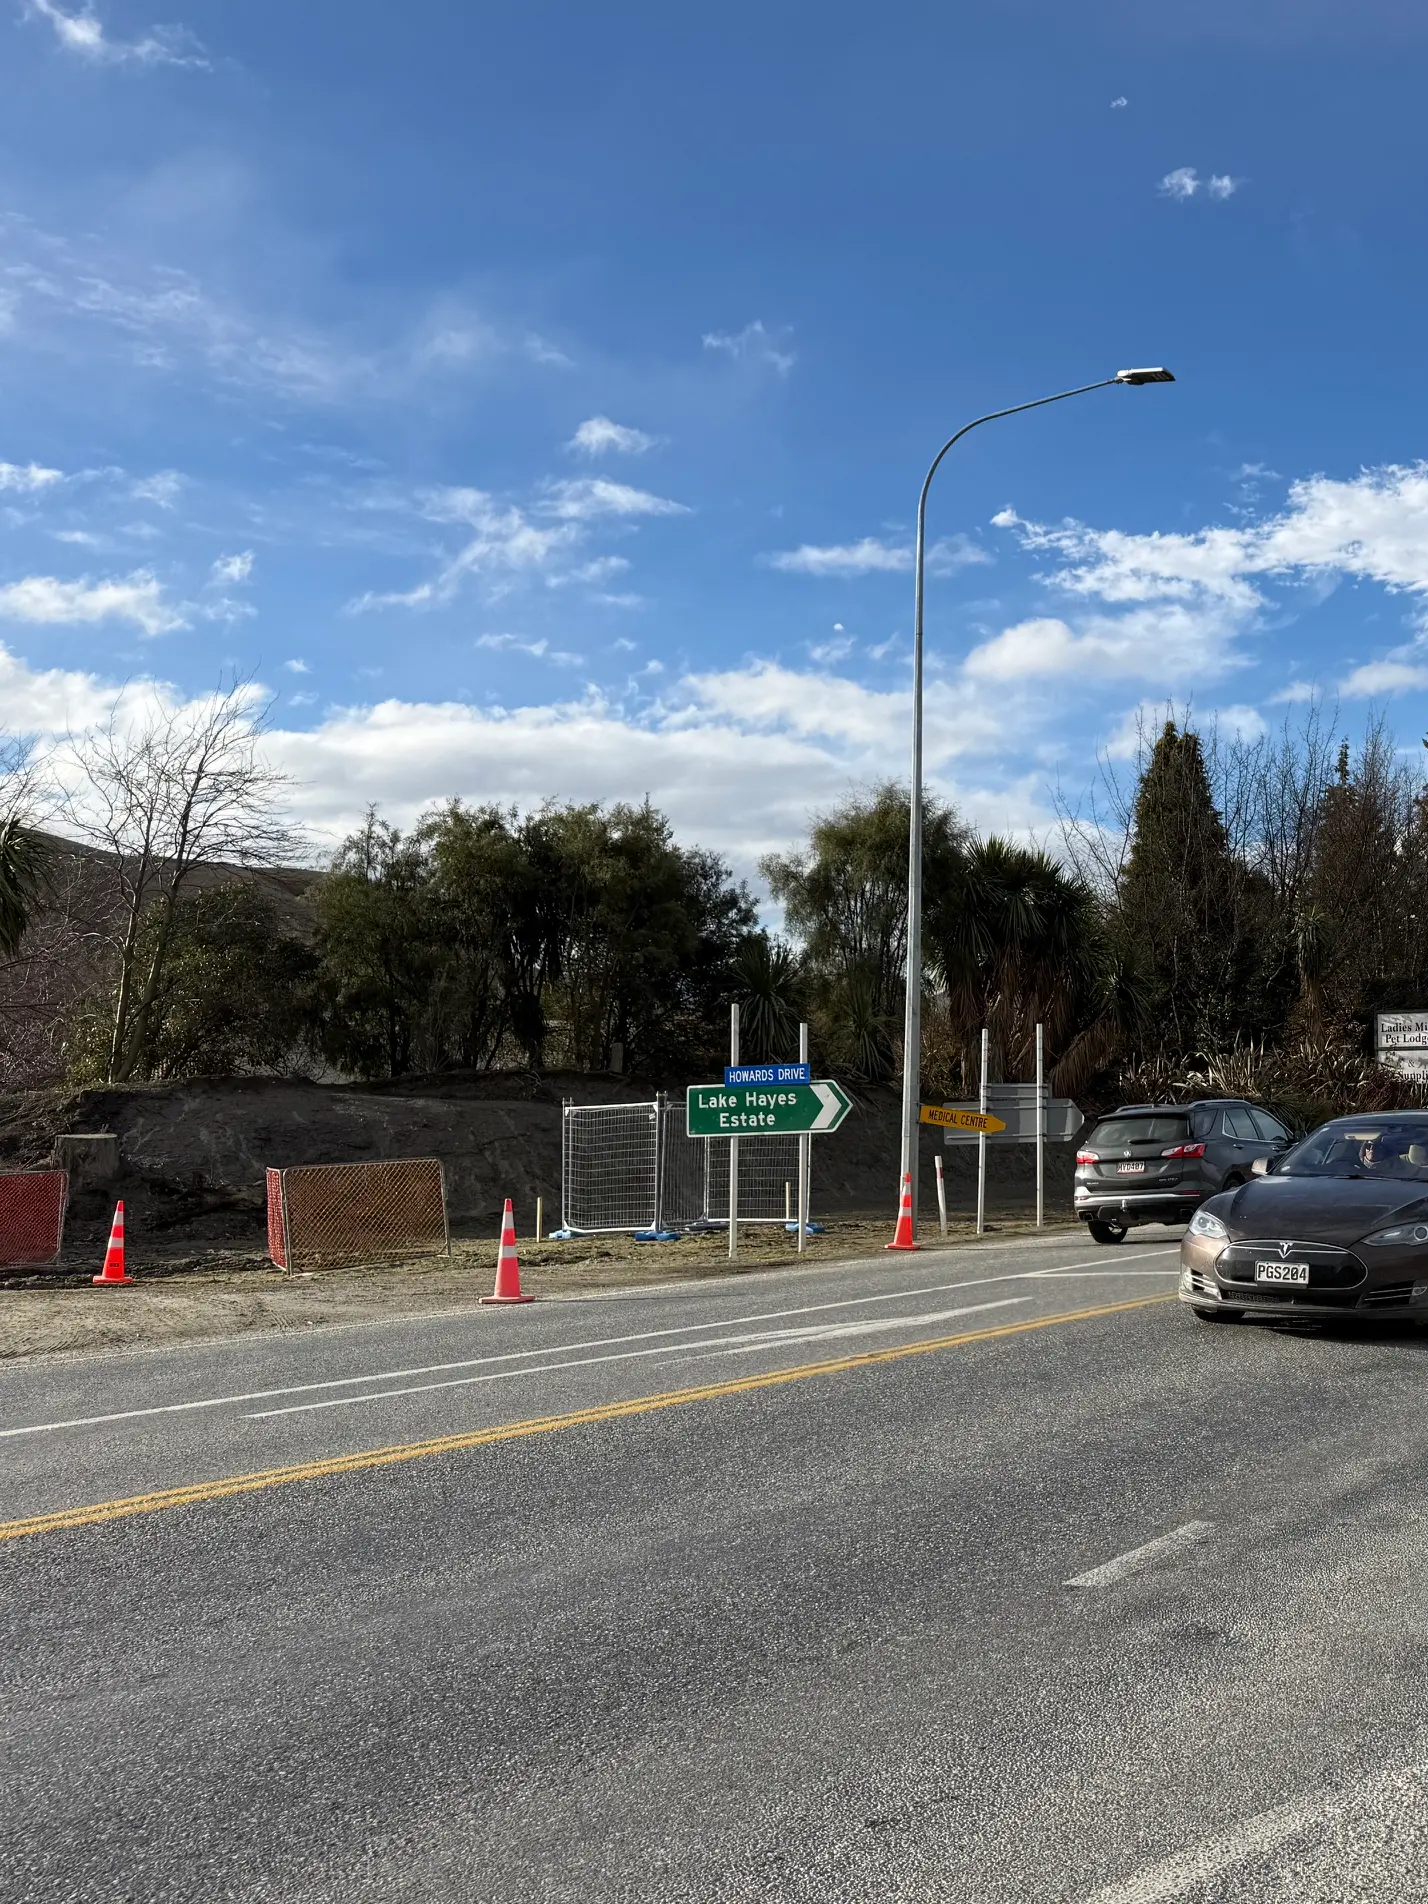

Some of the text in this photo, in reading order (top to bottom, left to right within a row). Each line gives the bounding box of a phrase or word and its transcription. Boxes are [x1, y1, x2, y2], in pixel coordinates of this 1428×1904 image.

[1381, 1022, 1412, 1033] Ladies
[1385, 1034, 1400, 1044] Pet
[729, 1067, 805, 1083] HOWARDS DRIVE
[698, 1091, 798, 1110] Lake Hayes
[719, 1111, 776, 1128] Estate
[928, 1108, 988, 1129] MEDICAL CENTRE
[1257, 1264, 1307, 1281] PGS204
